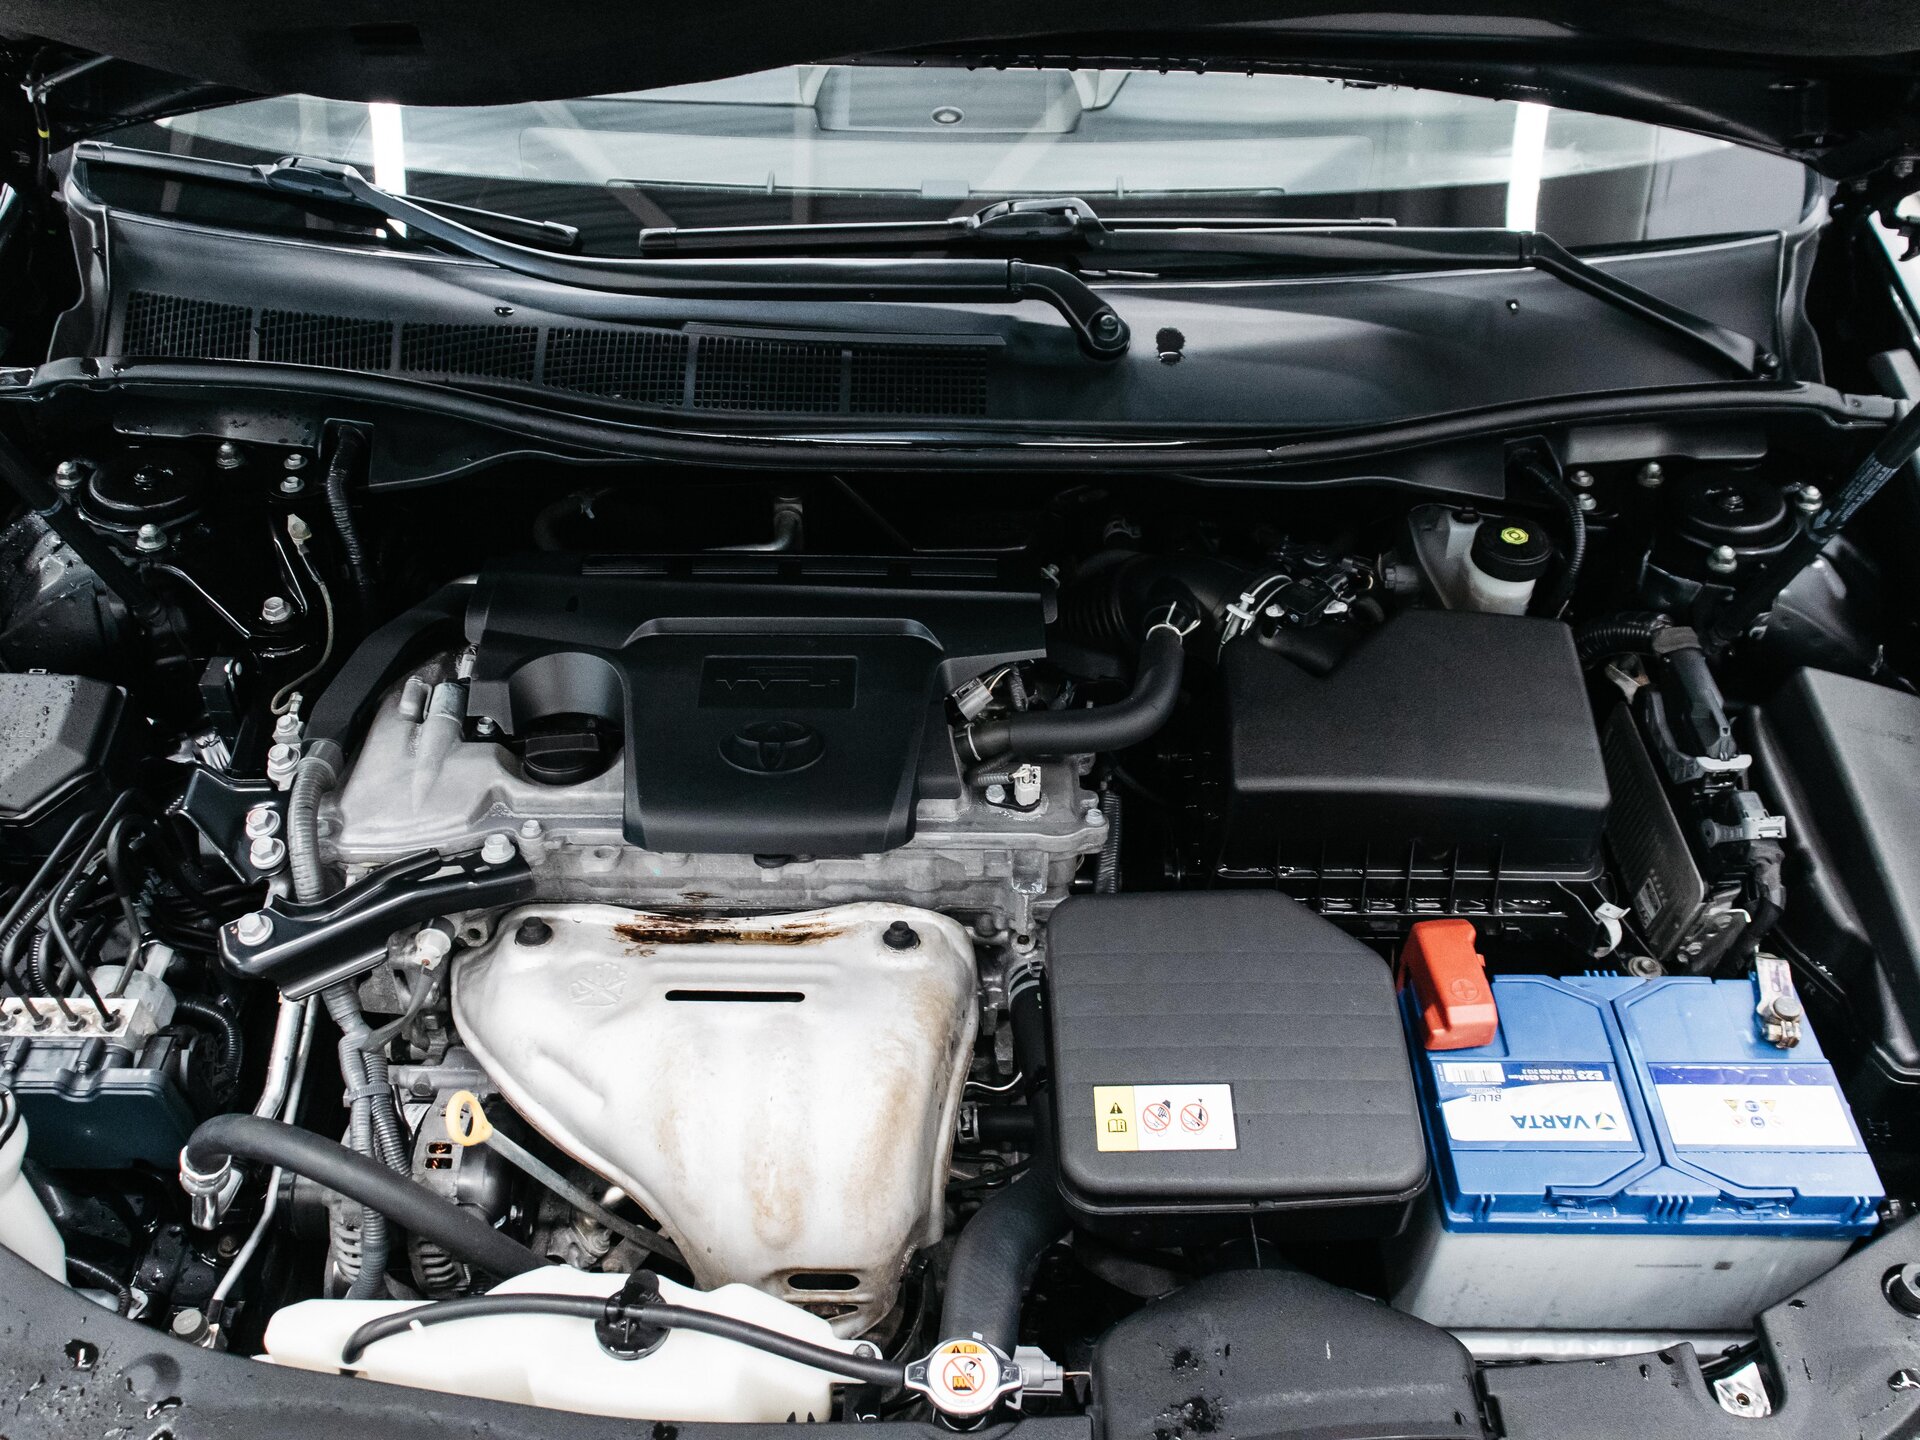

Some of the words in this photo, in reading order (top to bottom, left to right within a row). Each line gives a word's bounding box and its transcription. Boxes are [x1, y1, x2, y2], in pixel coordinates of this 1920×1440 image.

[1576, 1070, 1605, 1081] E23
[1470, 1094, 1502, 1103] BLUE
[1510, 1114, 1591, 1130] VARTA
